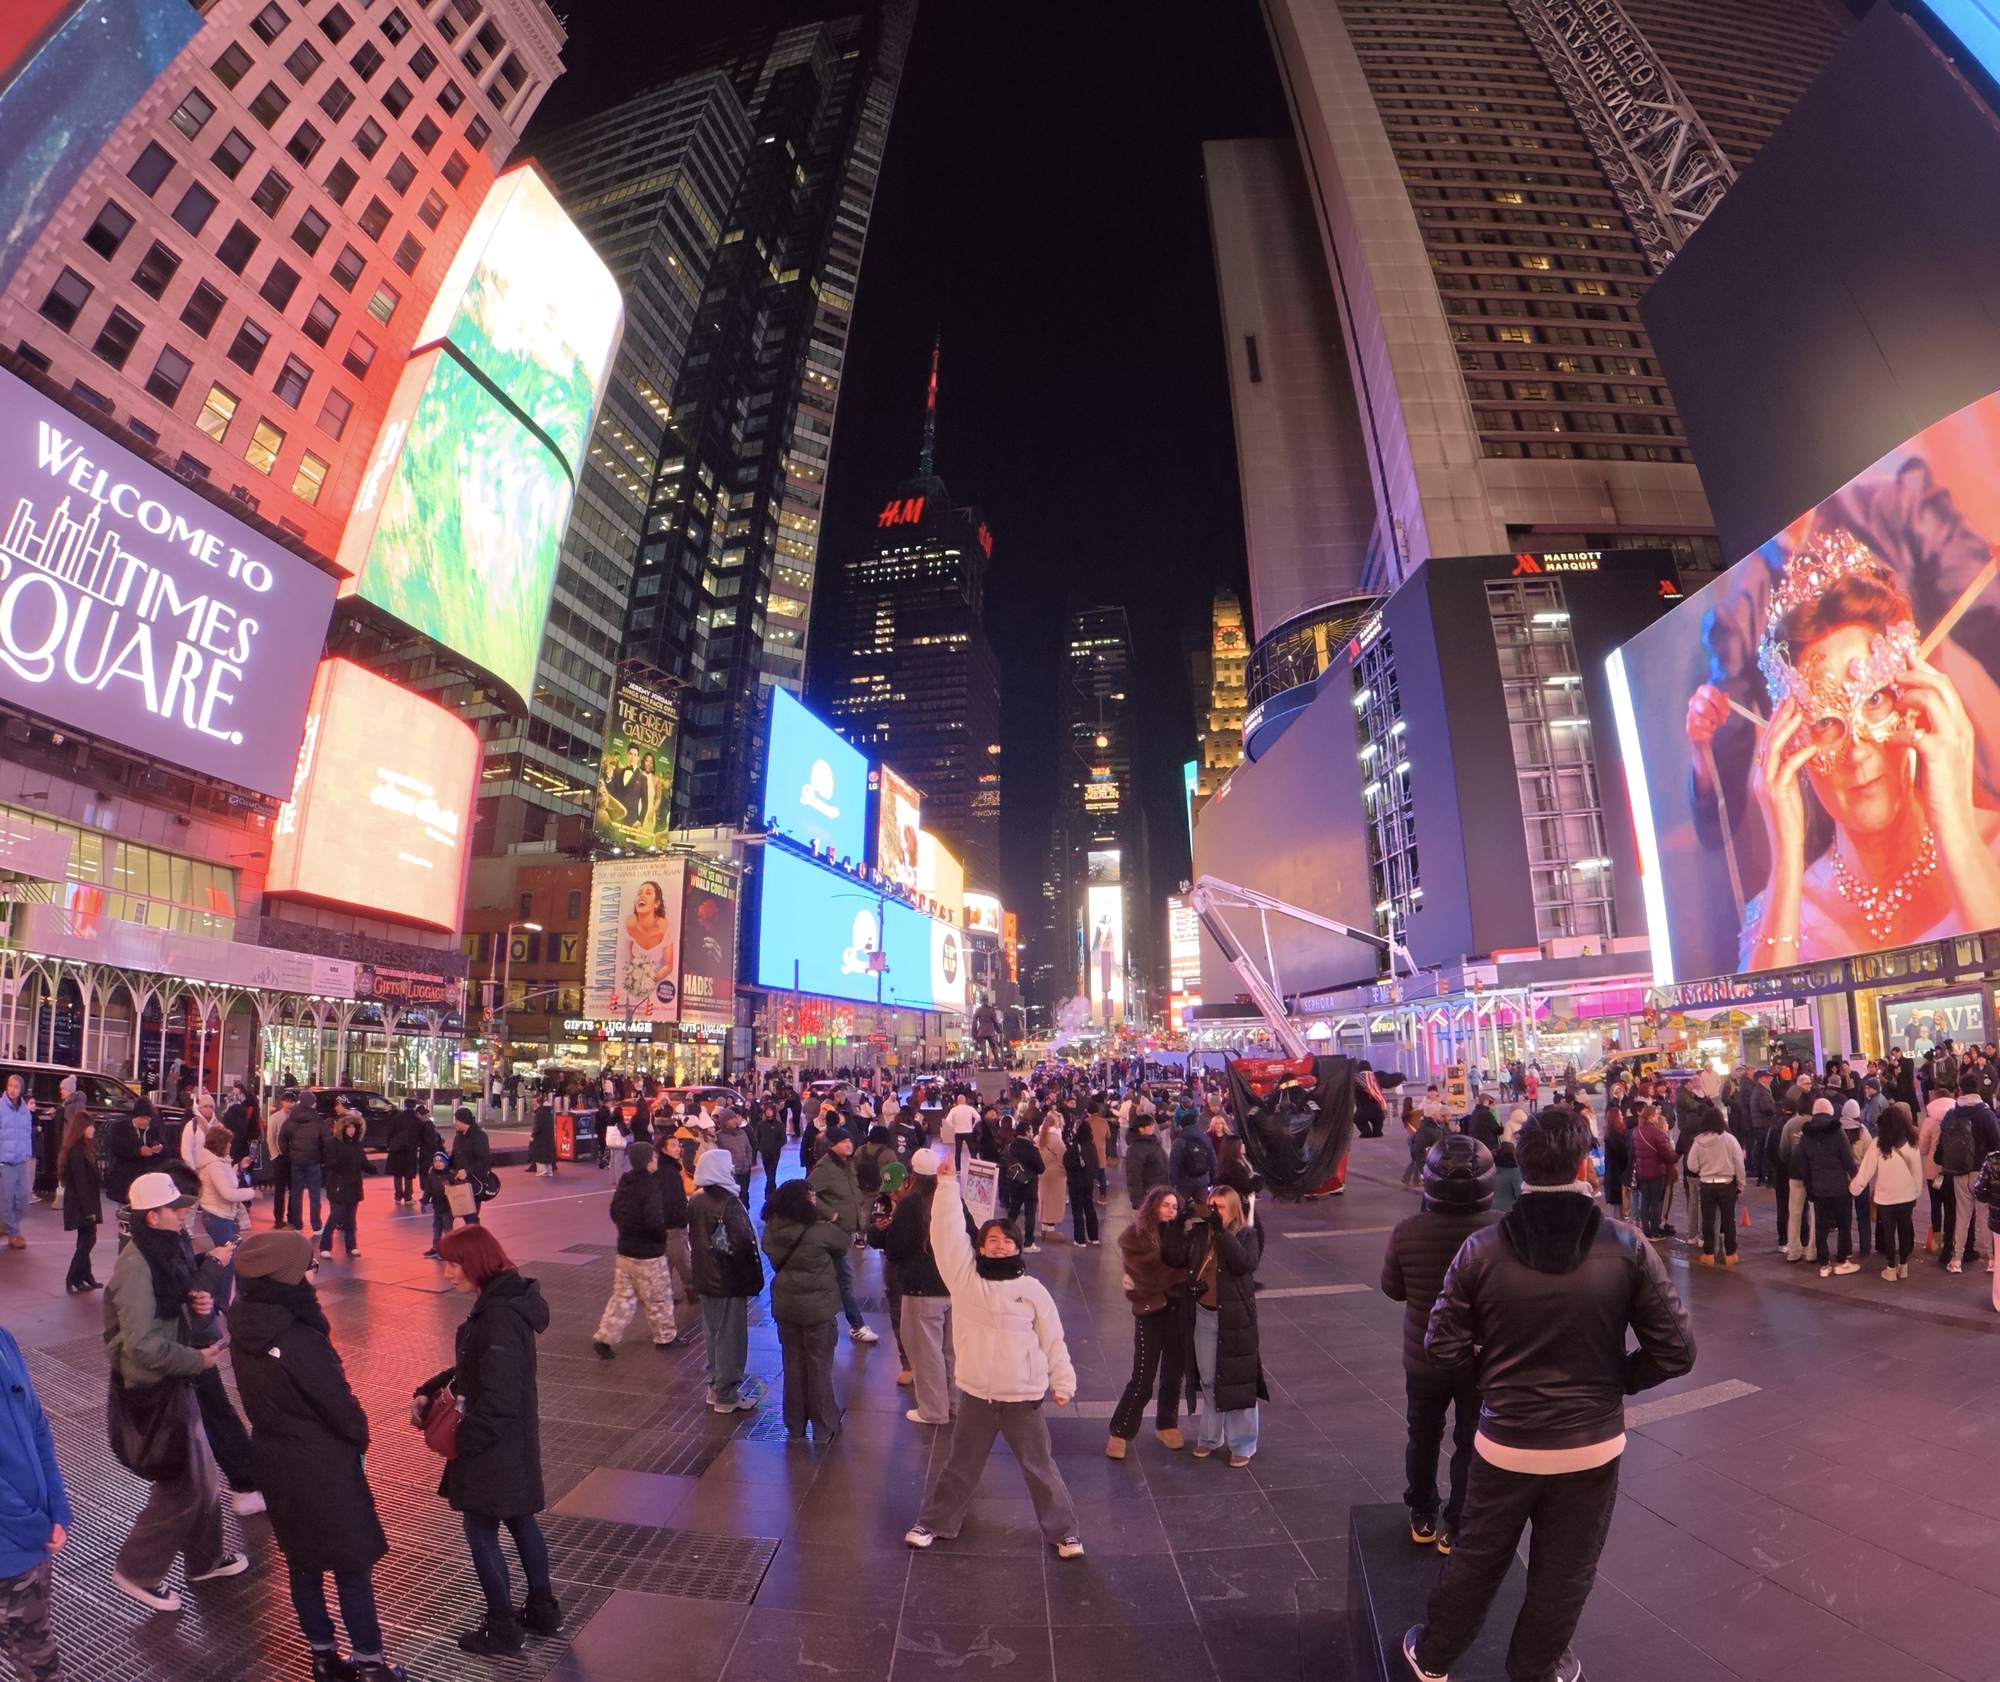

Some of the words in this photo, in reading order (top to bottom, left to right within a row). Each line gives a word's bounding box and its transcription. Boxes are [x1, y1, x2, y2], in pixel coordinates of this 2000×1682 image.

[37, 418, 227, 567] WELCOME
[227, 547, 274, 594] TO
[878, 496, 925, 528] H&M
[1544, 552, 1602, 562] MARRIOTT
[1546, 562, 1599, 572] MARQUIS
[114, 551, 259, 664] TIMES
[619, 700, 638, 722] THE
[639, 711, 675, 737] GREAT
[623, 721, 667, 747] GATSBY
[1084, 791, 1119, 800] MERLIN
[690, 874, 709, 891] WORLD
[710, 879, 727, 897] COULD
[600, 886, 621, 924] MIA!
[339, 942, 409, 967] EXPRESS
[594, 928, 619, 992] MAMMA
[374, 976, 400, 995] GIFTS
[407, 979, 445, 1000] LUGGAGE
[684, 974, 713, 997] HADES
[1304, 996, 1335, 1012] SEPHORA
[564, 1020, 594, 1030] GIFTS
[601, 1020, 652, 1033] LUGAGE
[679, 1022, 697, 1033] GIFTS
